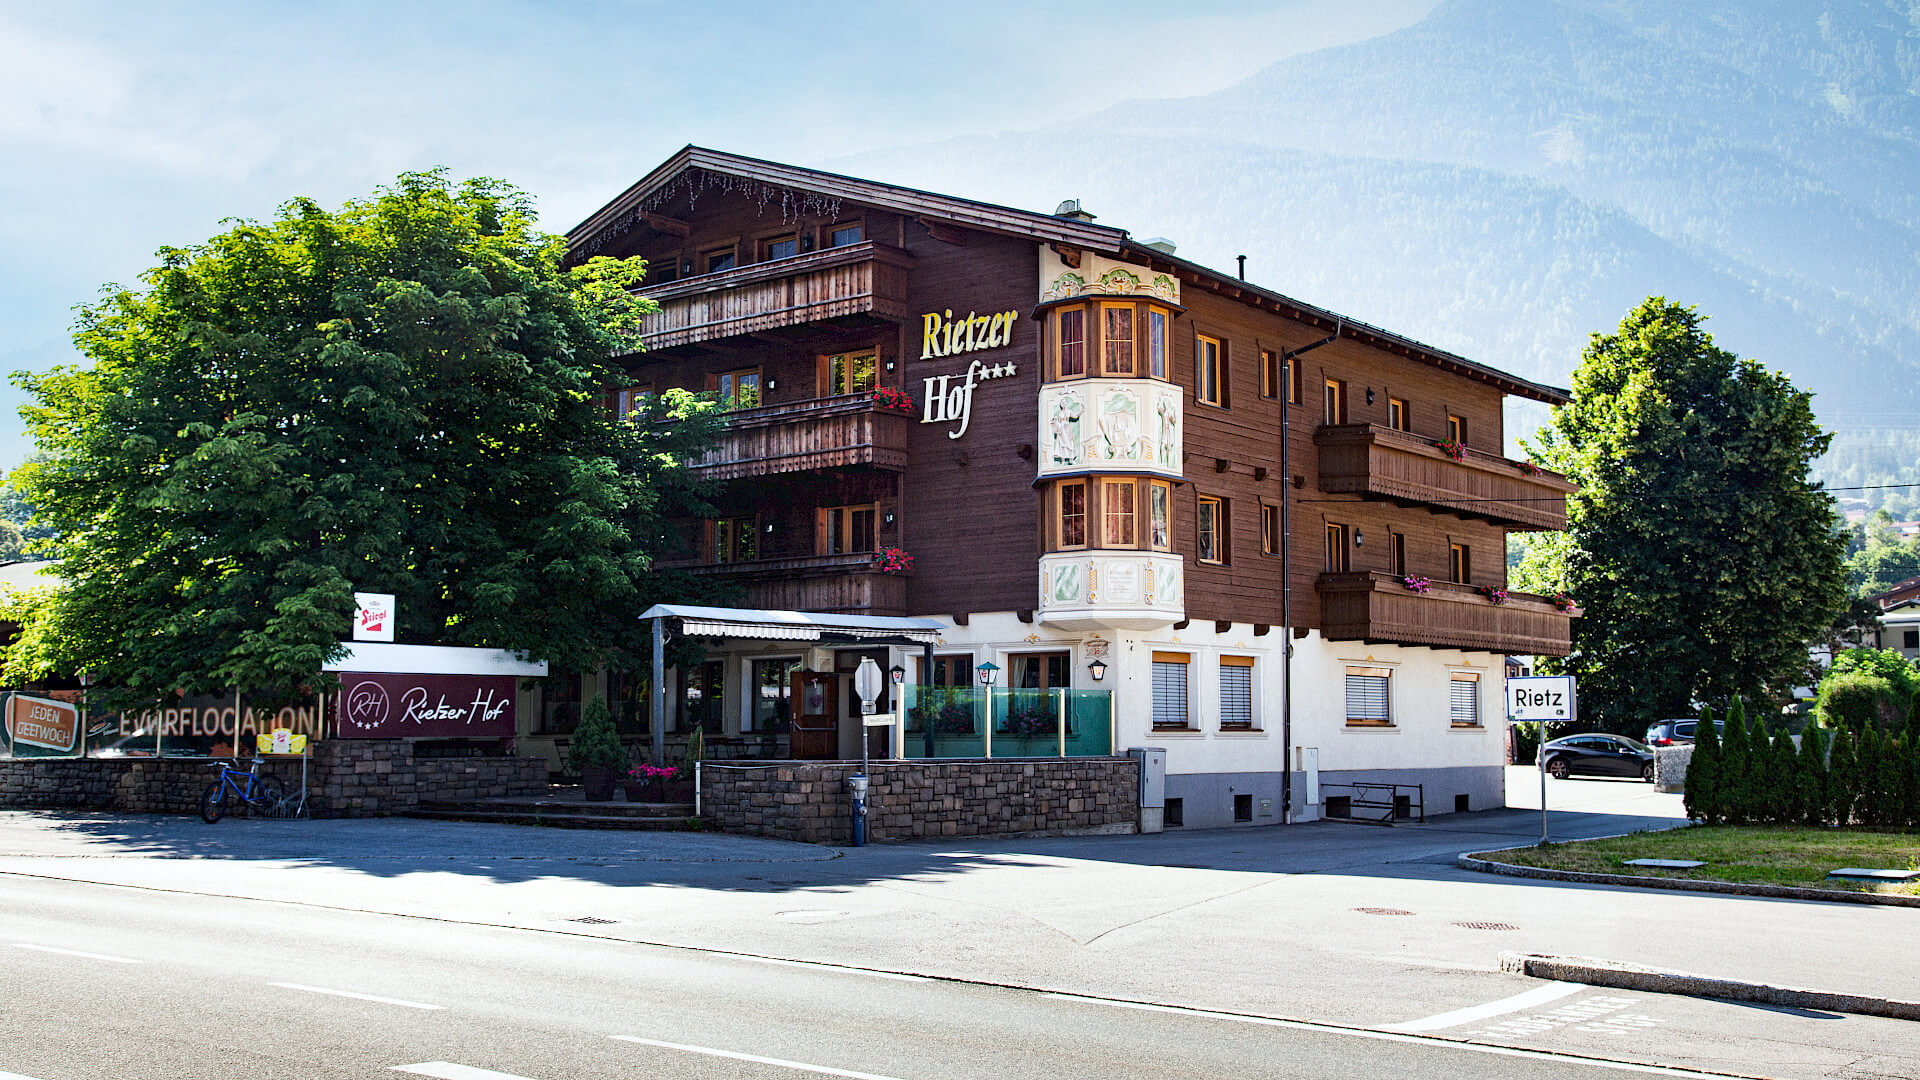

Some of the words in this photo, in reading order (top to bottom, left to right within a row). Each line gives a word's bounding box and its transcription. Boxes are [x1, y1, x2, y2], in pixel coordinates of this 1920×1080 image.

[920, 308, 1018, 359] Rietzer
[920, 360, 981, 439] Hof
[361, 608, 387, 626] Stiegl
[352, 691, 384, 718] RH
[400, 687, 468, 724] Rietzer
[466, 687, 510, 725] Hof
[1515, 688, 1563, 707] Rietz
[29, 705, 61, 724] JEDEN
